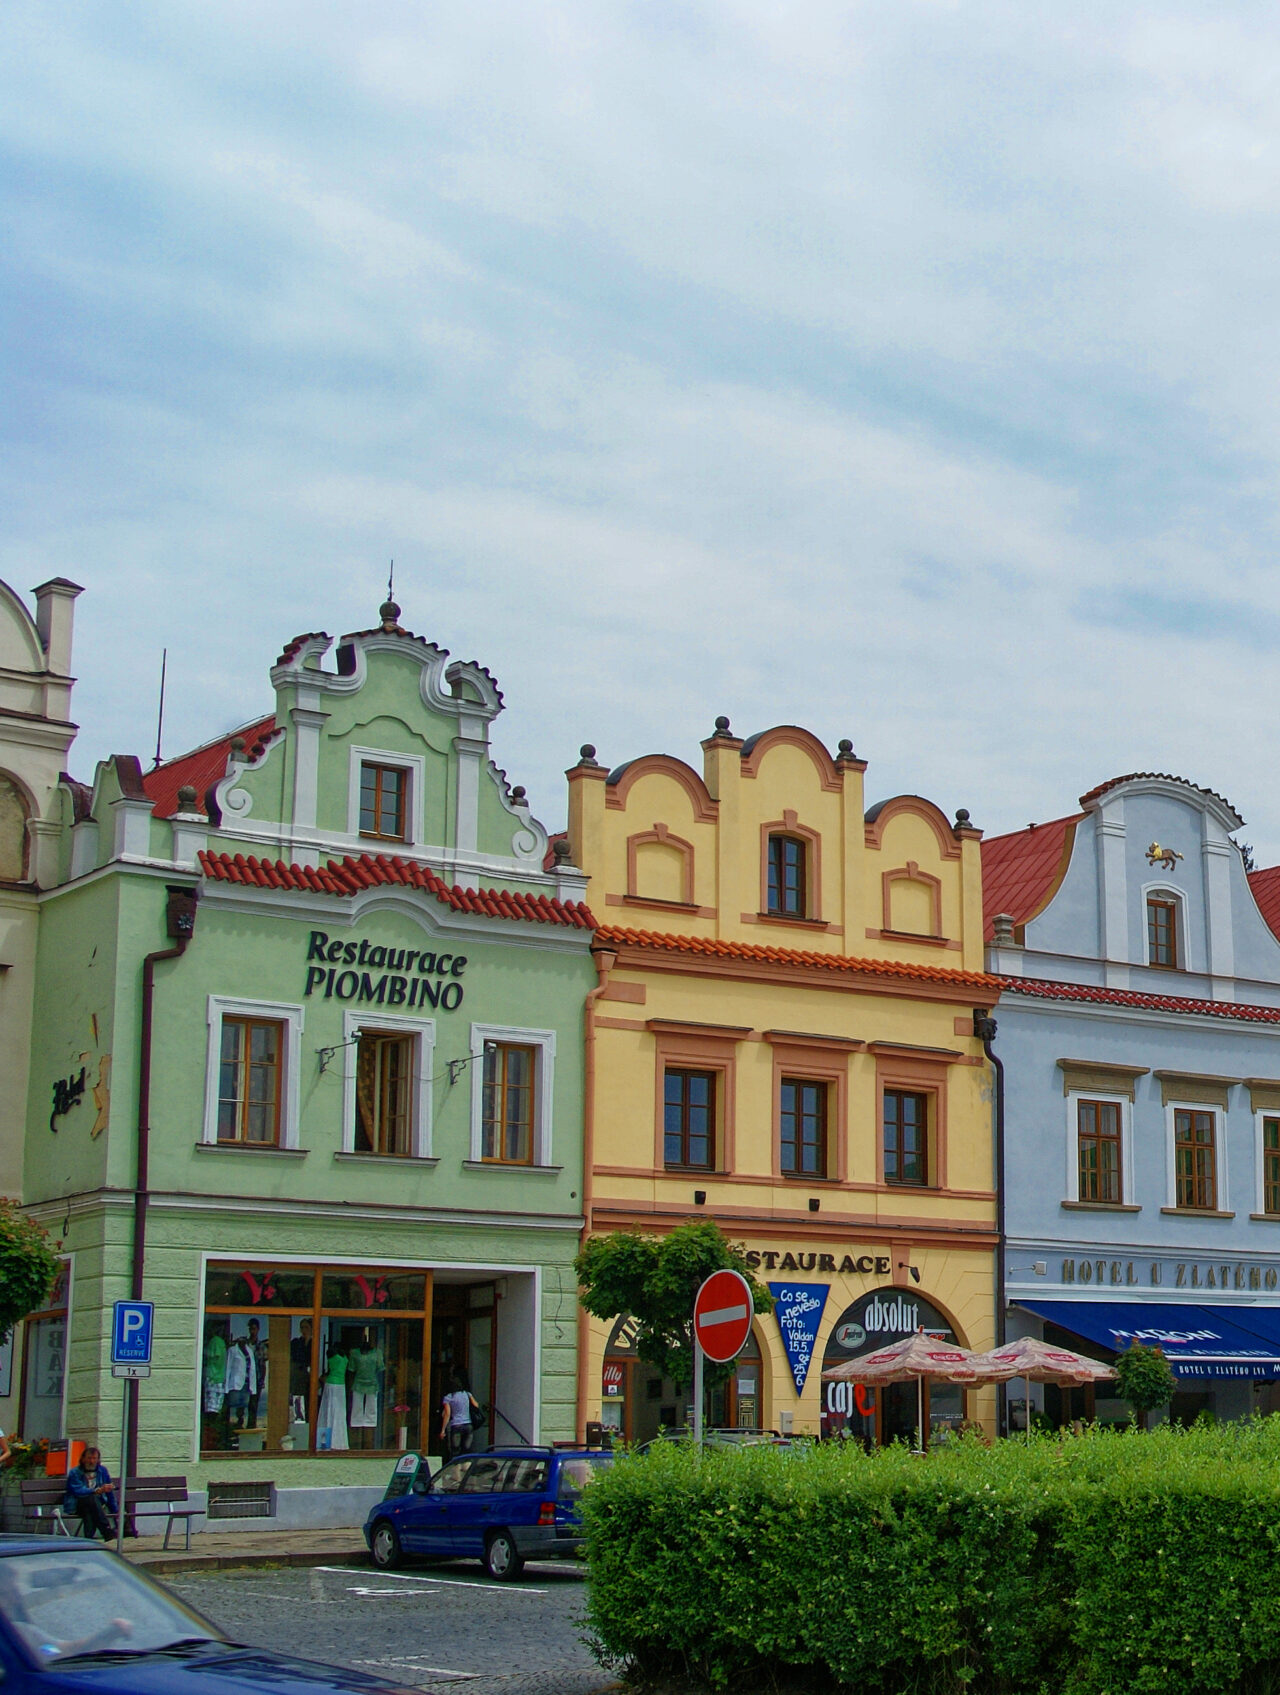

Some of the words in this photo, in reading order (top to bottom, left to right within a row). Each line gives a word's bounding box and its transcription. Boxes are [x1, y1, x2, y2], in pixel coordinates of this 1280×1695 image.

[306, 930, 468, 977] Restaurace
[304, 966, 464, 1010] PIOMBINO
[1063, 1259, 1138, 1283] HOTEL
[1151, 1262, 1163, 1285] U
[1176, 1262, 1278, 1289] ZLATÉHO
[780, 1289, 793, 1302] Co
[795, 1291, 808, 1302] se
[781, 1315, 806, 1328] Foto:
[865, 1296, 919, 1333] absolut
[123, 1310, 144, 1342] P
[1108, 1328, 1223, 1342] MATTONI
[127, 1367, 137, 1376] 1x
[604, 1366, 622, 1384] illy
[1179, 1365, 1205, 1374] HOTEL
[1253, 1367, 1266, 1376] LVA
